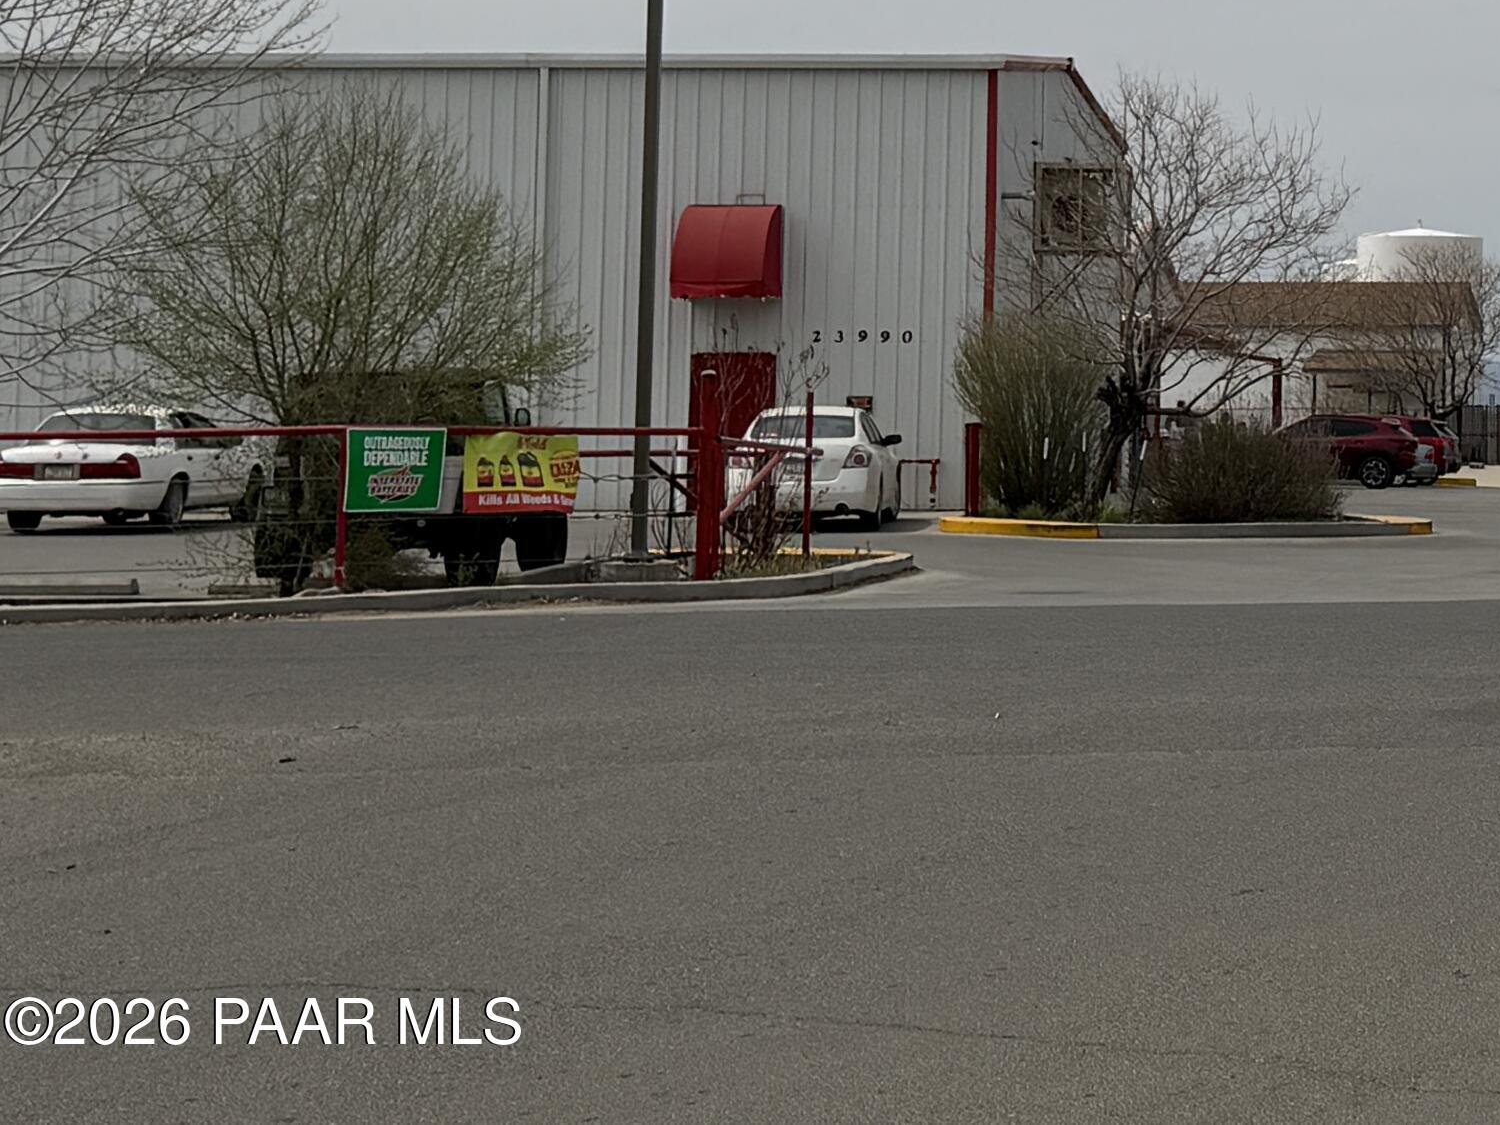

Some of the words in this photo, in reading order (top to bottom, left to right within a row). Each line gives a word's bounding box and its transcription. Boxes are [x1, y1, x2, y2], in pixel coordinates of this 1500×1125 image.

[812, 330, 913, 343] 23990
[364, 436, 430, 449] OUTRAGEOUSLY
[363, 450, 429, 466] DEPENDABLE
[479, 494, 503, 506] Kills
[505, 493, 520, 504] All
[522, 494, 551, 505] Weeds
